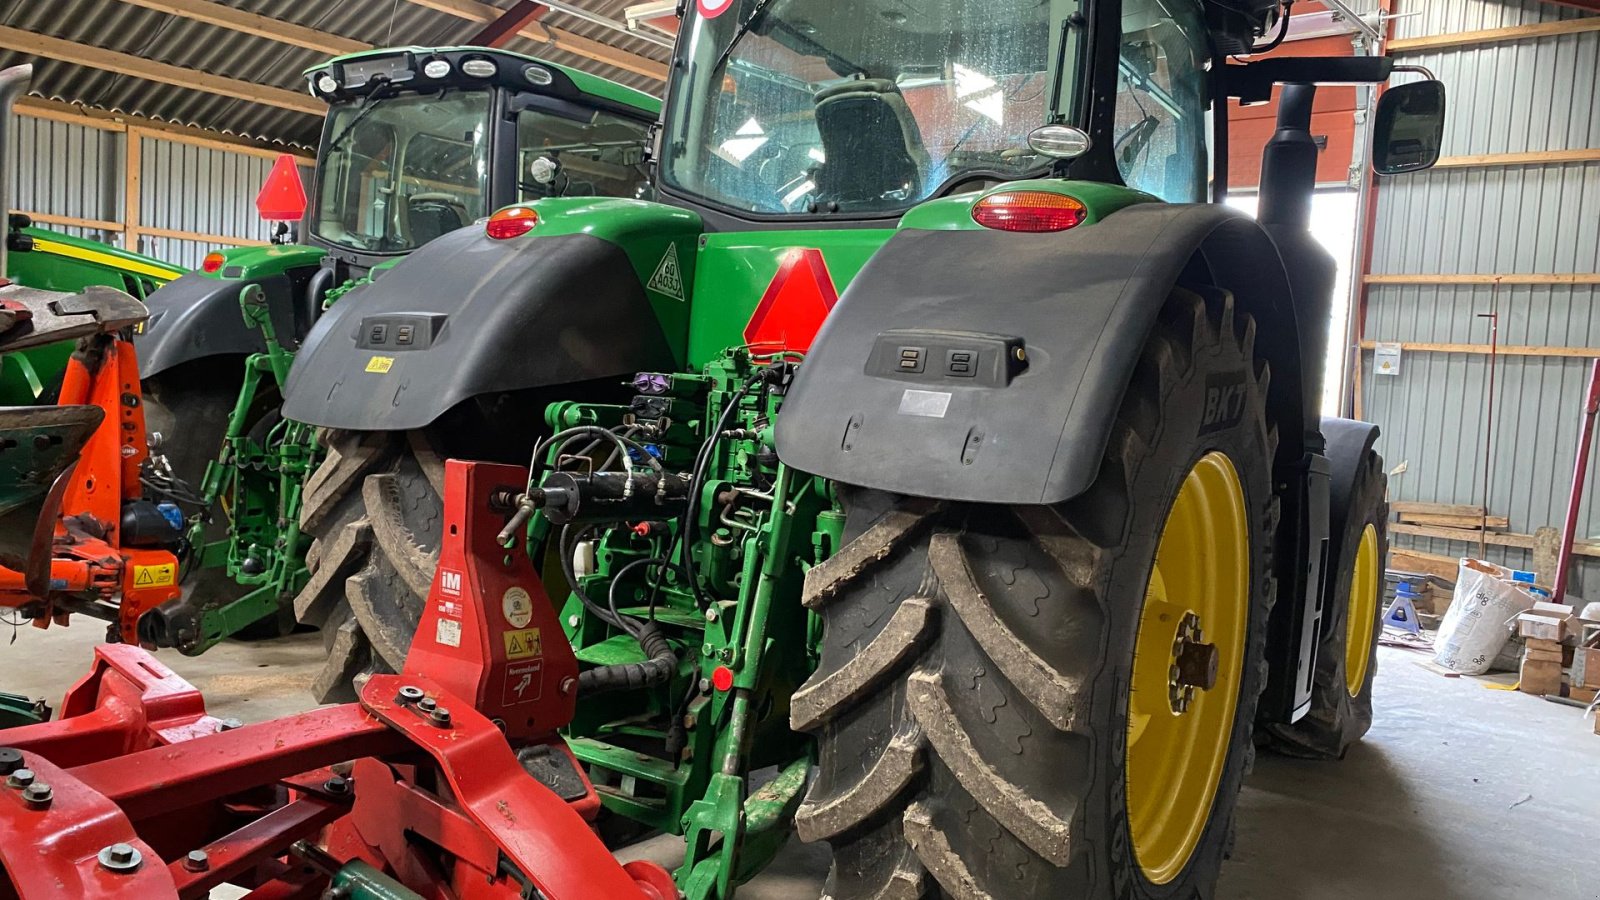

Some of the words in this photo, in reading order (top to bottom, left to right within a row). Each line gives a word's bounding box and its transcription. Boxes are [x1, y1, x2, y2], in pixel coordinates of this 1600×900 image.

[664, 262, 675, 276] 60
[1203, 384, 1246, 425] BKT
[442, 571, 461, 591] iM
